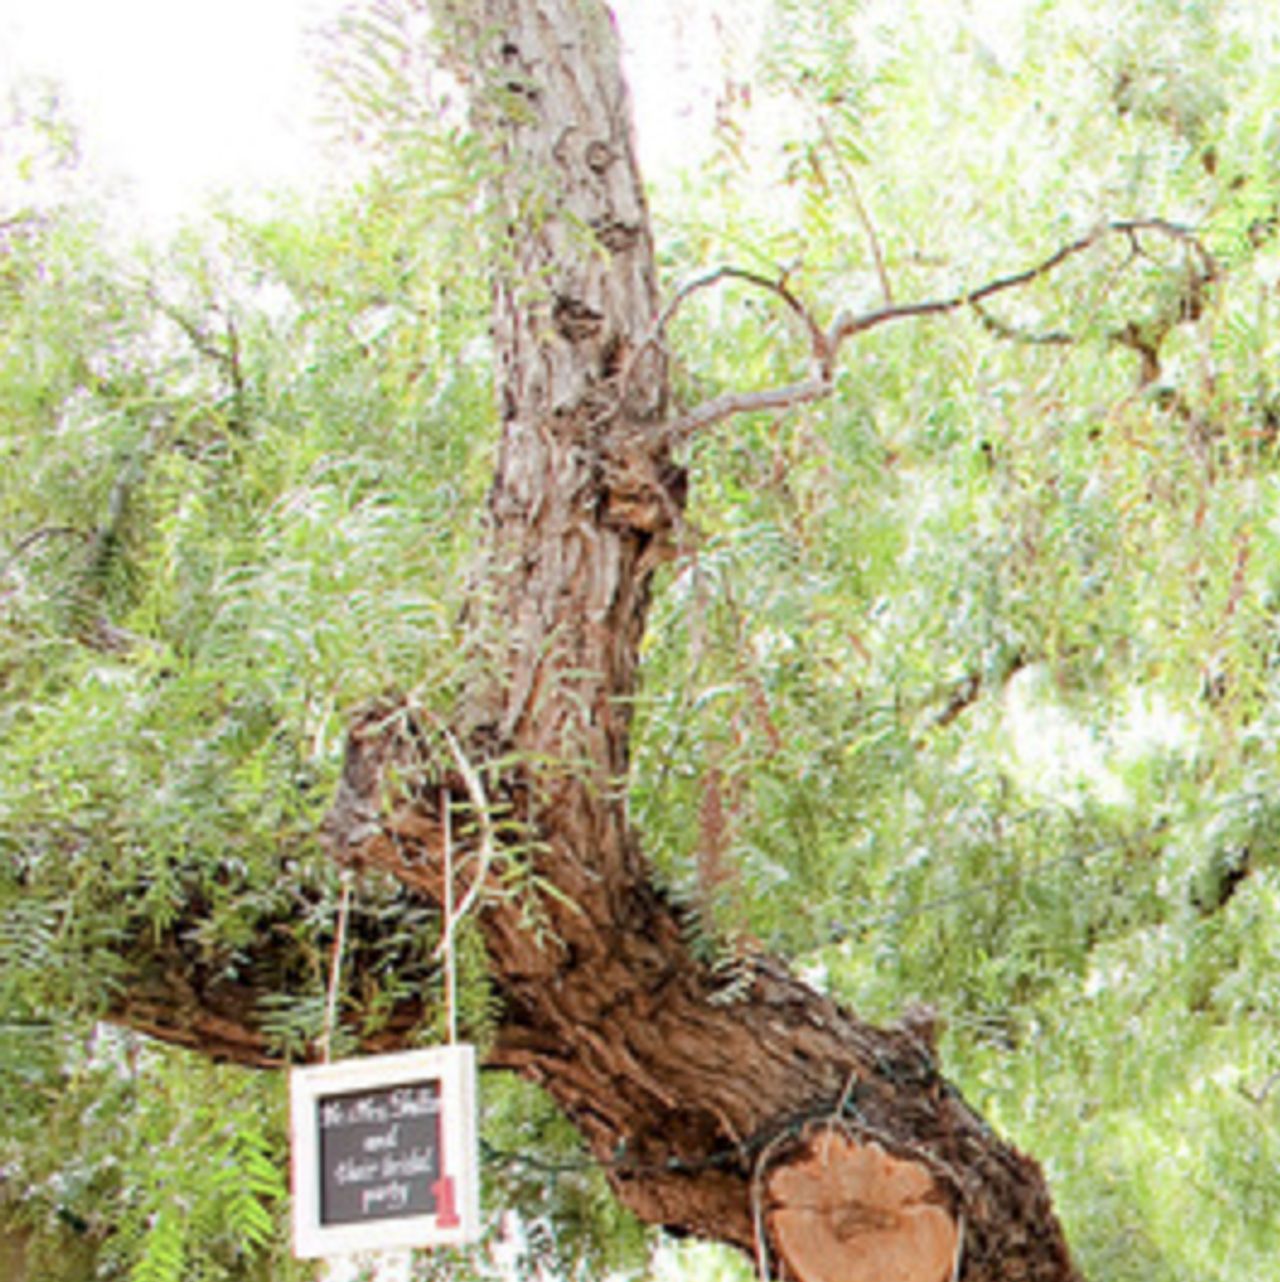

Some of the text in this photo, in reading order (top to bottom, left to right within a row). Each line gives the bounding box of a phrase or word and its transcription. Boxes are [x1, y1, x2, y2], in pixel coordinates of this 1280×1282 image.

[363, 1123, 400, 1152] and
[362, 1180, 411, 1214] party
[431, 1175, 461, 1229] 1
